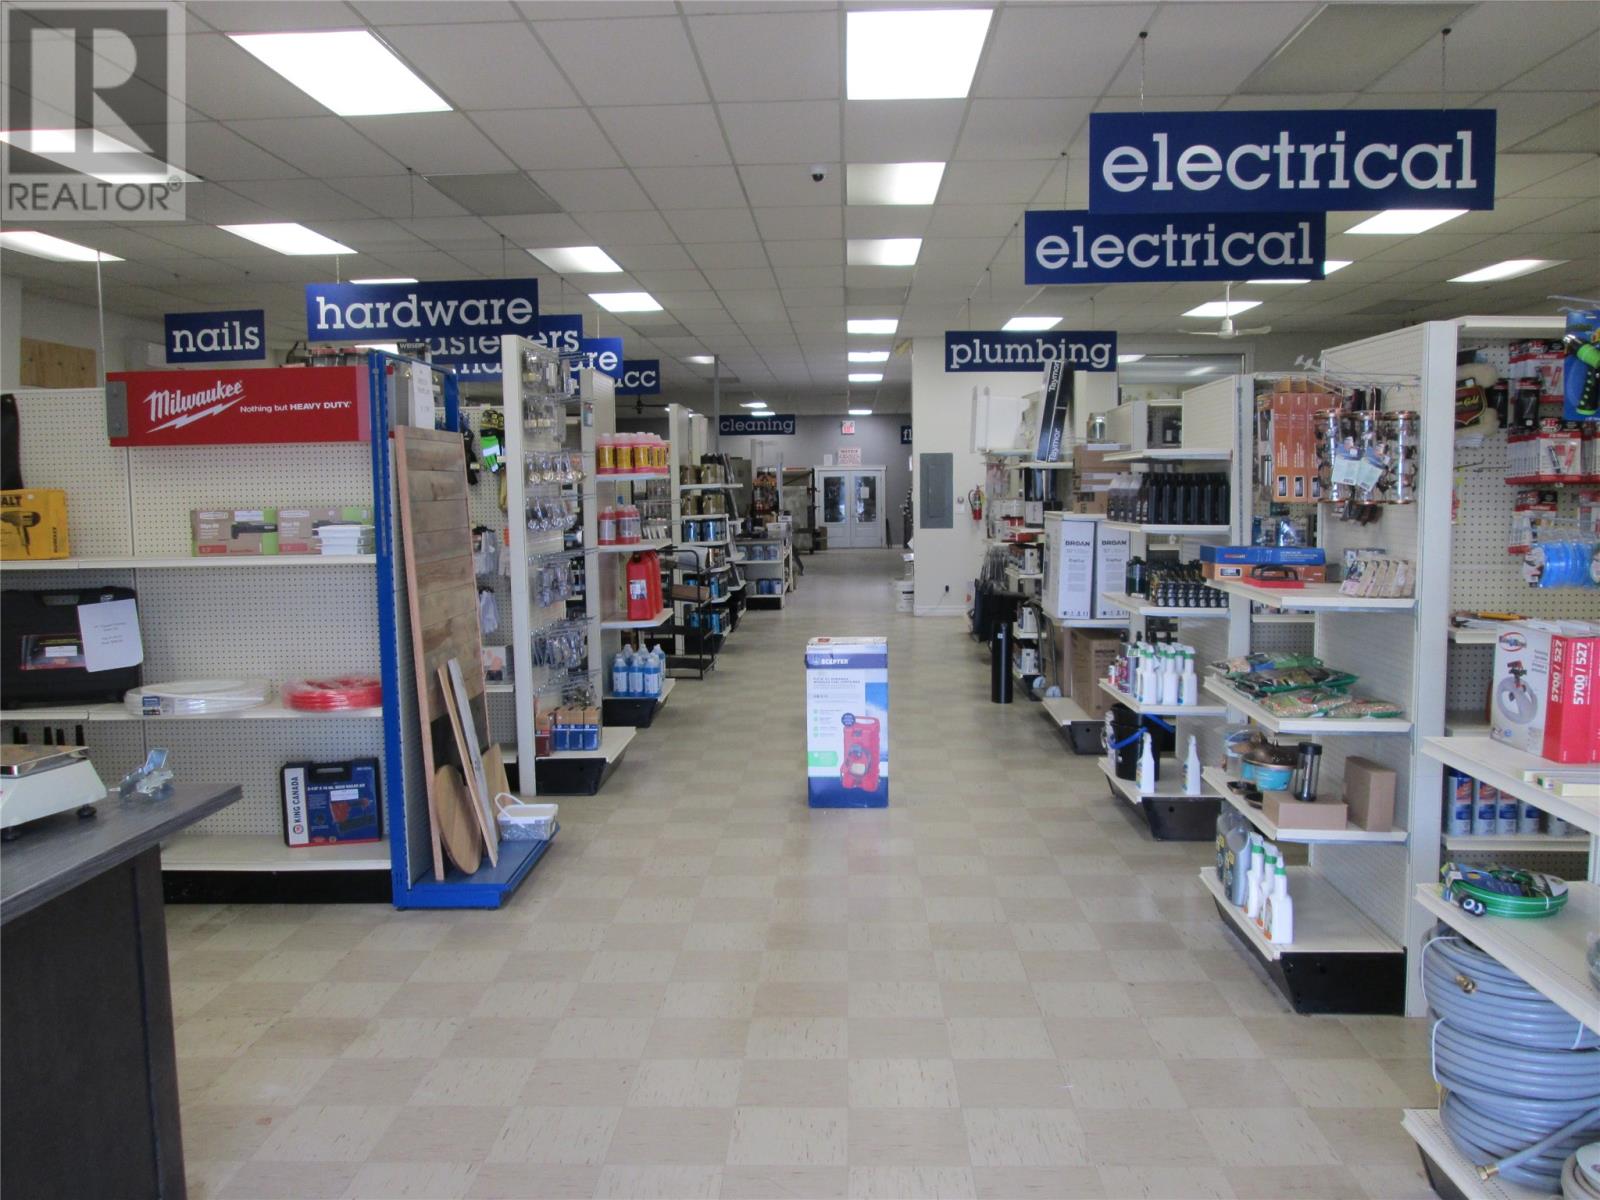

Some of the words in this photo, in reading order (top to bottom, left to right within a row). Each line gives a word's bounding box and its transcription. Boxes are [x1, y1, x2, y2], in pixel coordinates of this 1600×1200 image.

[1102, 130, 1478, 194] electrical
[1035, 222, 1314, 271] electrical
[315, 294, 533, 329] hardware
[172, 320, 260, 353] nails
[950, 338, 1112, 369] plumbing
[1048, 361, 1061, 392] Taymor
[143, 380, 242, 422] Milwaukee
[239, 404, 272, 414] Nothing
[274, 404, 288, 412] but
[289, 402, 321, 411] HEAVY
[720, 418, 794, 434] cleaning
[1049, 428, 1060, 461] Taymor
[1554, 640, 1563, 662] 527
[1576, 642, 1587, 665] 527
[1551, 672, 1560, 703] 5700
[1573, 674, 1585, 705] 5700
[290, 776, 301, 805] CANADA
[292, 806, 302, 824] KING
